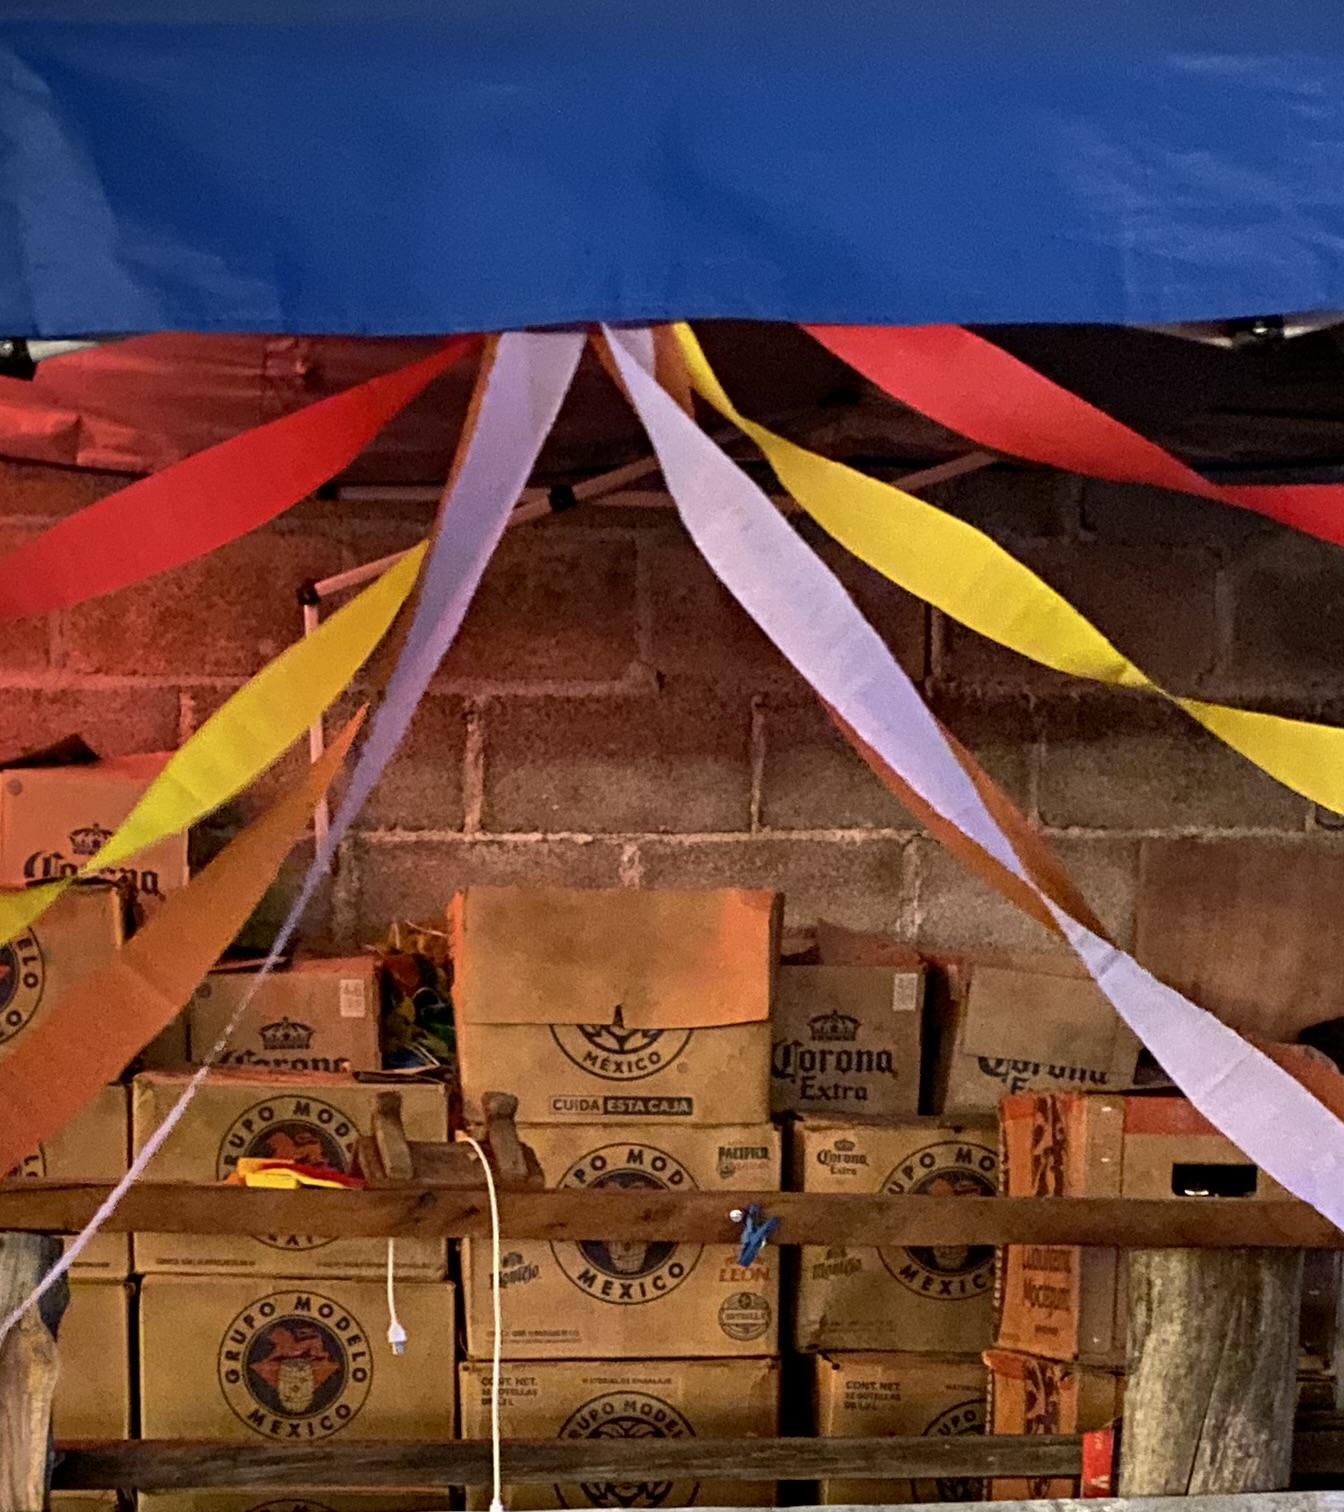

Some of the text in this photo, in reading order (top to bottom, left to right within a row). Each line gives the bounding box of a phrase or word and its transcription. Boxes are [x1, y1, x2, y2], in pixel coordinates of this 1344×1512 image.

[771, 1037, 899, 1084] Corona
[552, 1098, 691, 1114] CUIDA ESTA CAJA
[800, 1076, 868, 1101] Extra
[223, 1106, 274, 1180] RUPO
[816, 1149, 869, 1167] Corona
[626, 1149, 684, 1186] MOD
[887, 1152, 936, 1194] UPO
[577, 1263, 684, 1300] MEXICO
[899, 1263, 995, 1296] MEXIC
[224, 1295, 368, 1384] GRUPO MODELO
[247, 1408, 352, 1438] MEXICO
[567, 1400, 683, 1439] RUPO MODEL
[938, 1408, 977, 1435] UPO
